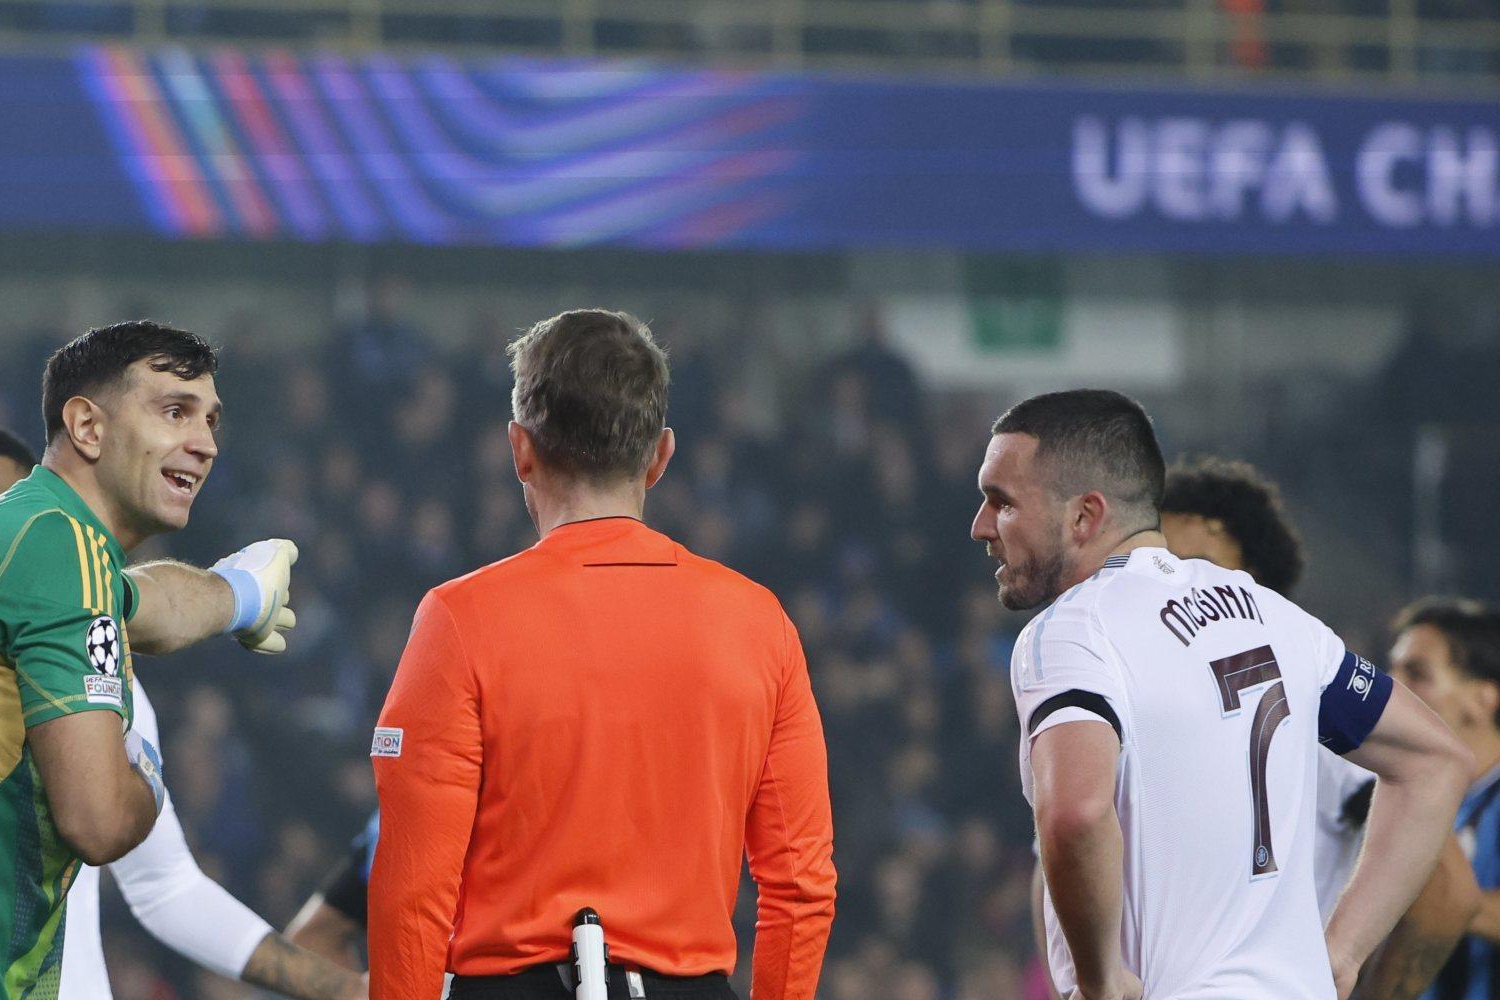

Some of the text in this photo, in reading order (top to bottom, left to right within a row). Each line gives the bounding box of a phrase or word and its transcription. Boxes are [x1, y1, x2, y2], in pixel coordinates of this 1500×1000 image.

[1071, 114, 1500, 228] UEFA CH
[1208, 644, 1291, 881] 7
